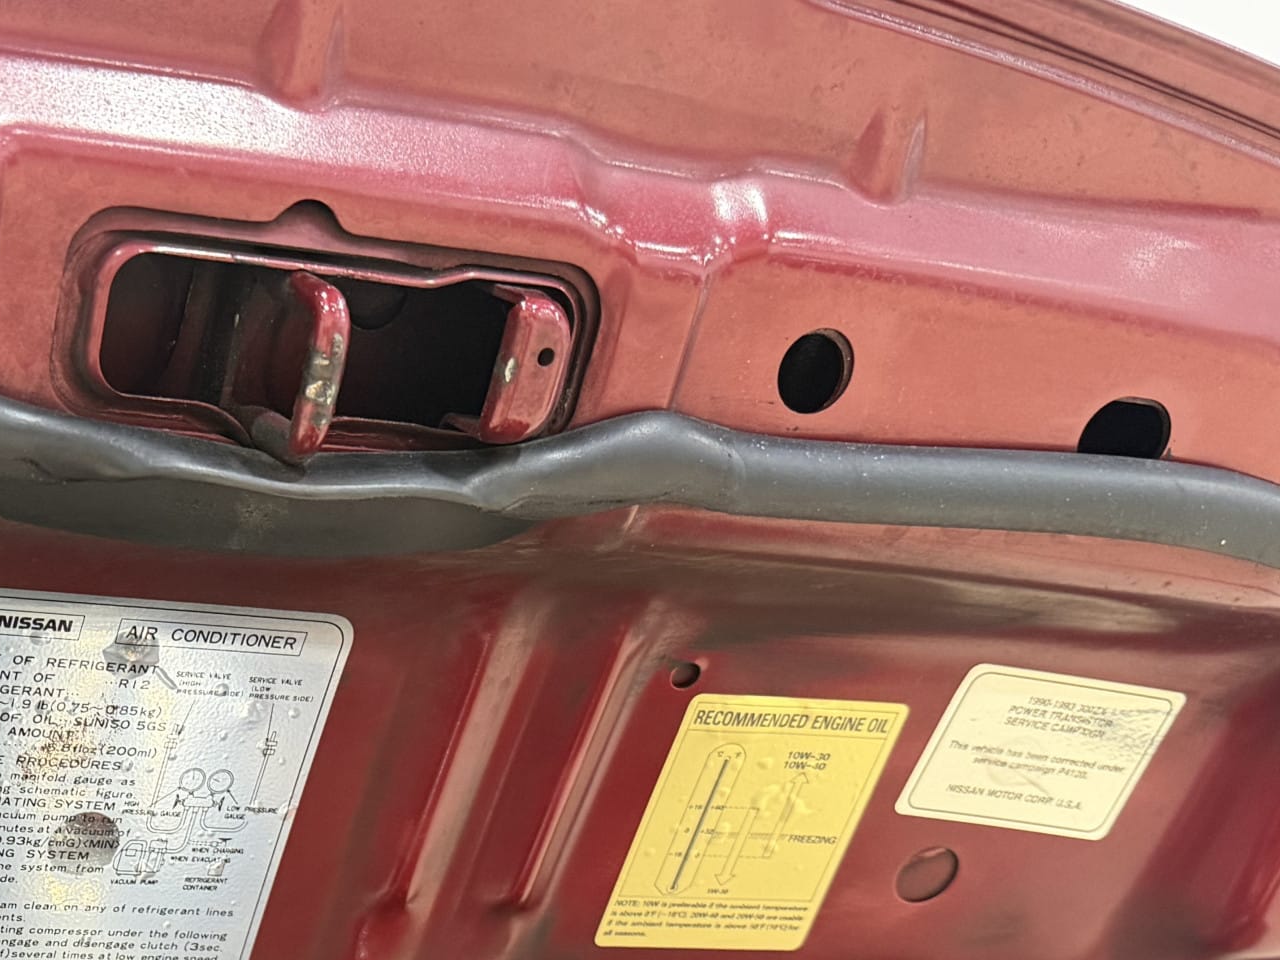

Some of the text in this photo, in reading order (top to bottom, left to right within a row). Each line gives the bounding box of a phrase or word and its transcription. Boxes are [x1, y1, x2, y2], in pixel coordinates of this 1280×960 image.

[126, 625, 297, 650] AIR CONDITIONER
[12, 655, 35, 665] OF
[46, 657, 159, 675] REFRIGERANT
[33, 672, 55, 683] OF
[0, 712, 21, 722] OF
[1009, 705, 1048, 718] POWER
[693, 709, 888, 734] RECOMMENDED ENGINE OIL
[1004, 716, 1049, 731] SERVICE
[7, 726, 73, 740] AMOUNT
[16, 756, 121, 771] PROCEDURES
[946, 784, 985, 796] NISSAN
[987, 789, 1023, 800] MOTOR
[54, 799, 116, 811] SYSTEM
[788, 835, 837, 845] FREEZING
[26, 849, 90, 861] SYSTEM
[23, 901, 57, 911] clean
[84, 904, 107, 913] any
[113, 904, 126, 913] of
[132, 905, 200, 916] refrigerant
[206, 907, 234, 917] lines
[29, 926, 103, 938] compressor
[107, 928, 144, 938] under
[149, 929, 169, 939] the
[174, 930, 228, 942] following
